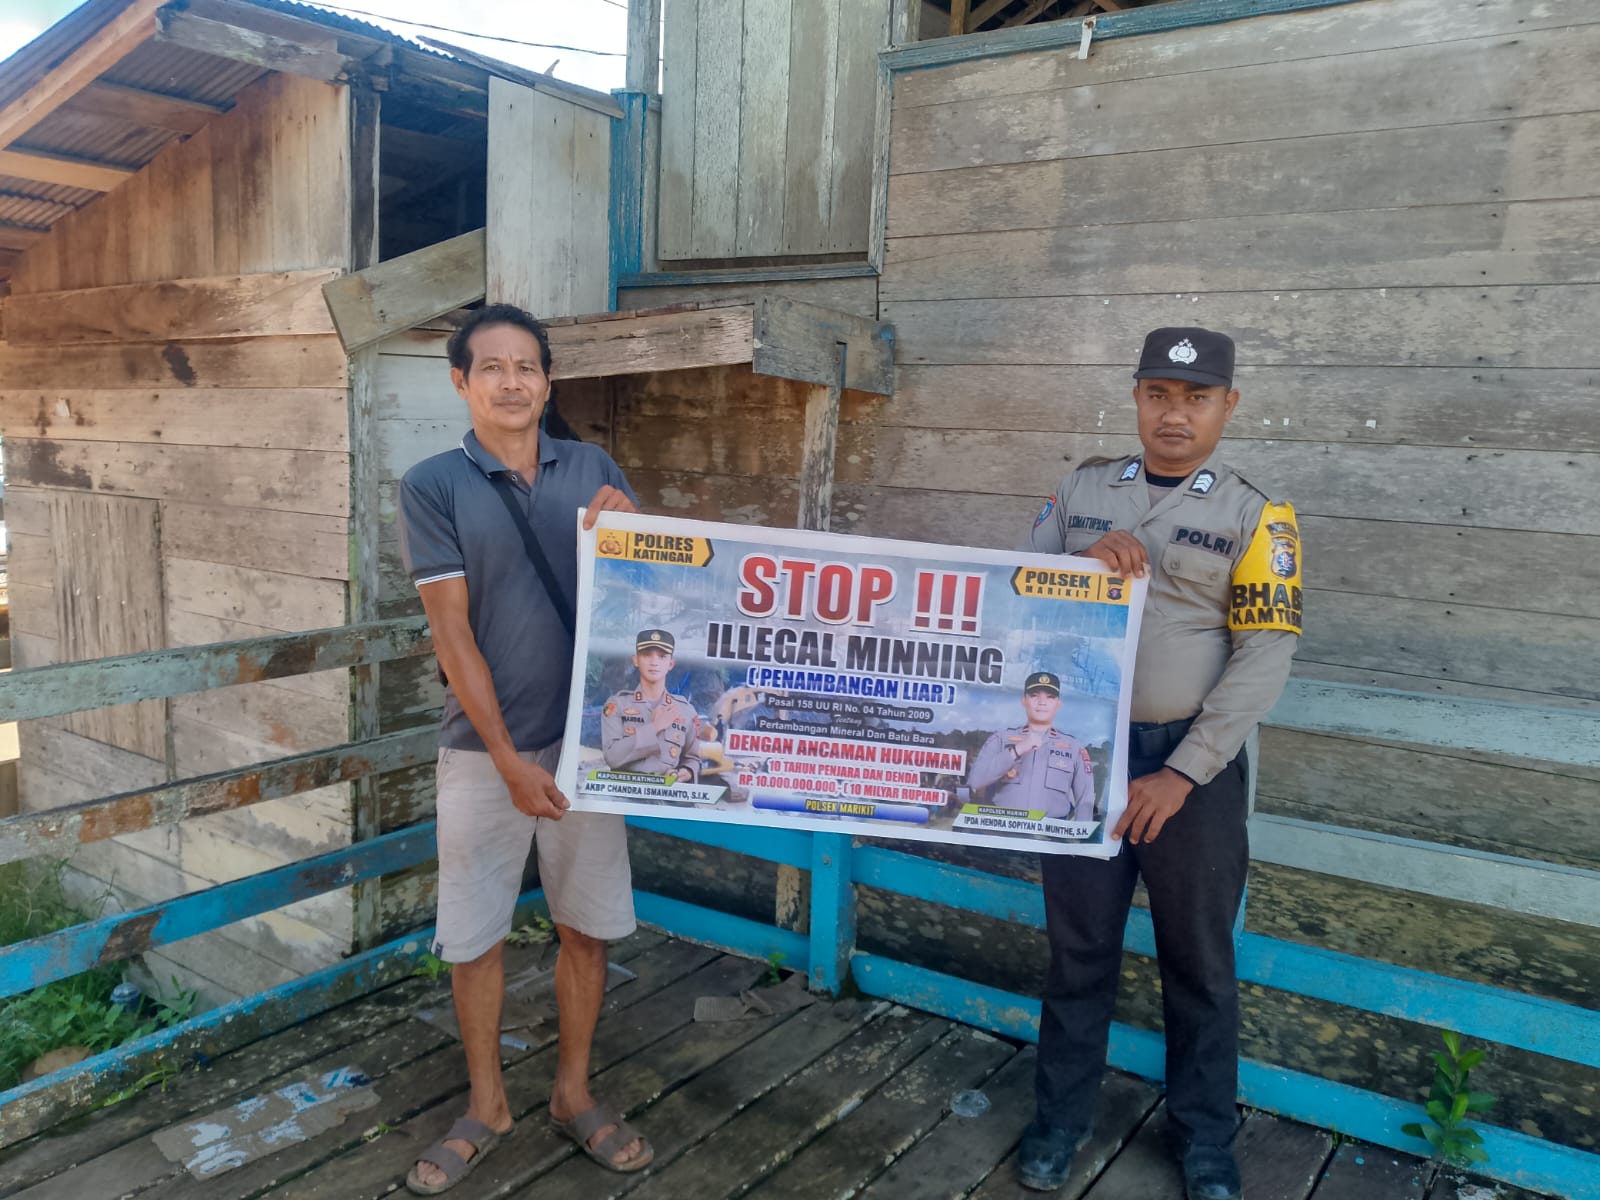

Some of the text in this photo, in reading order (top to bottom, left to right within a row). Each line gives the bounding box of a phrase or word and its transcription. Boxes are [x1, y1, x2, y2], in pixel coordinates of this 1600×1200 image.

[634, 532, 694, 552] POLRES
[1176, 528, 1234, 556] POLRI
[633, 548, 693, 564] KATINGAN
[1025, 570, 1092, 588] POLSEK
[738, 554, 983, 633] STOP !!!
[1025, 585, 1090, 598] MARIKIT
[706, 622, 1003, 684] ILLEGAL MINNING
[768, 697, 794, 707] Pasal
[798, 700, 813, 709] 158
[816, 702, 830, 710] UU
[832, 704, 842, 712] RI
[863, 706, 874, 714] 04
[877, 707, 906, 718] Tahun
[908, 710, 930, 720] 2009
[760, 720, 935, 744] Pertambangan Mineral Dan Batu Bara
[730, 734, 962, 771] DENGAN ANCAMAN HUKUMAN
[1050, 750, 1072, 759] POLRI
[770, 760, 918, 784] 10 TAHUN PENJARA DAN DENDA
[585, 782, 604, 792] AKBP
[608, 784, 642, 795] CHANDRA
[644, 788, 690, 800] ISMAWANTO,
[738, 774, 753, 786] RP.
[864, 785, 899, 798] MILYAR
[902, 788, 939, 803] RUPIAH
[806, 799, 876, 816] POLSEK MARIKIT
[964, 816, 980, 825] IPDA
[980, 818, 1006, 828] HENDRA
[1008, 820, 1036, 830] SOPIYAN
[1045, 824, 1075, 837] MUNTHE,
